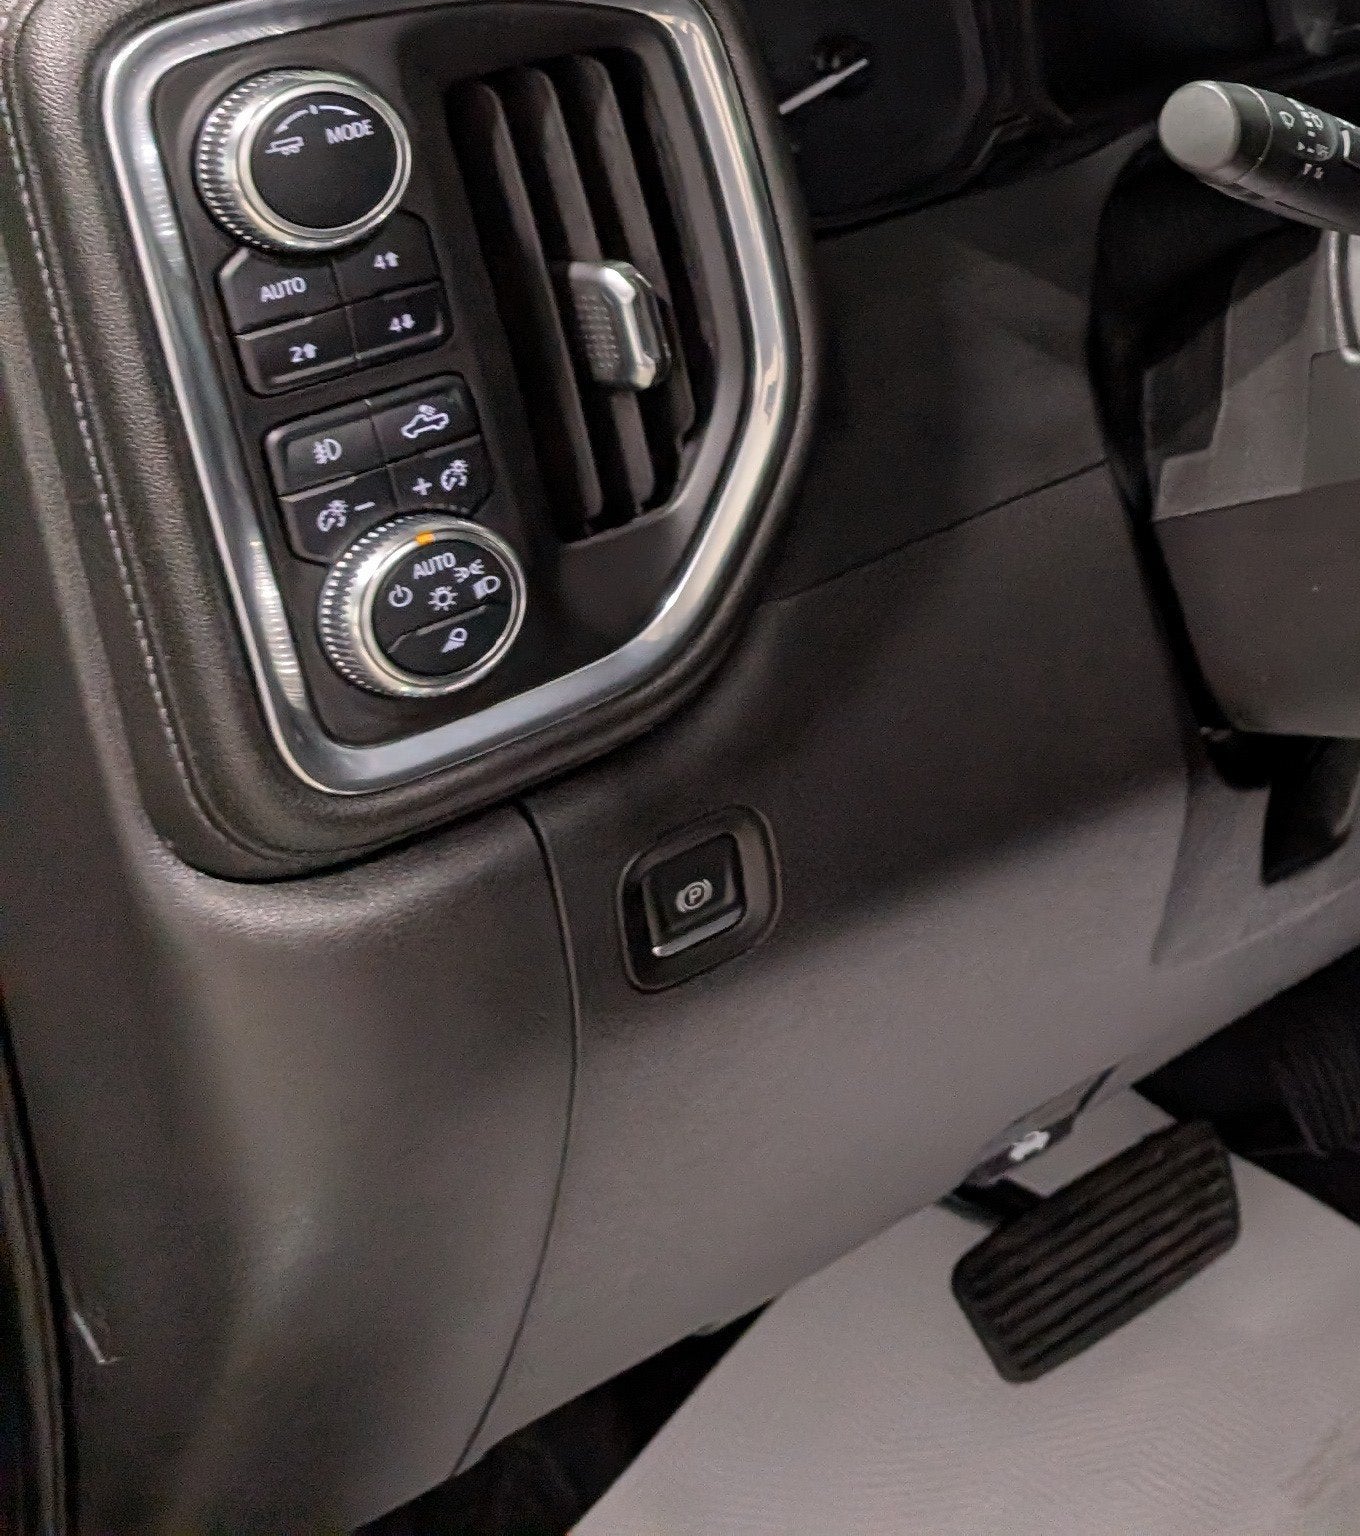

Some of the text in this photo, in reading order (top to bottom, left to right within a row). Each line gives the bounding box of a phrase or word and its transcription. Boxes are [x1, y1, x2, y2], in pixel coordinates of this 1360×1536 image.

[325, 119, 374, 144] MODE
[260, 277, 307, 303] AUTO
[413, 552, 457, 580] AUTO
